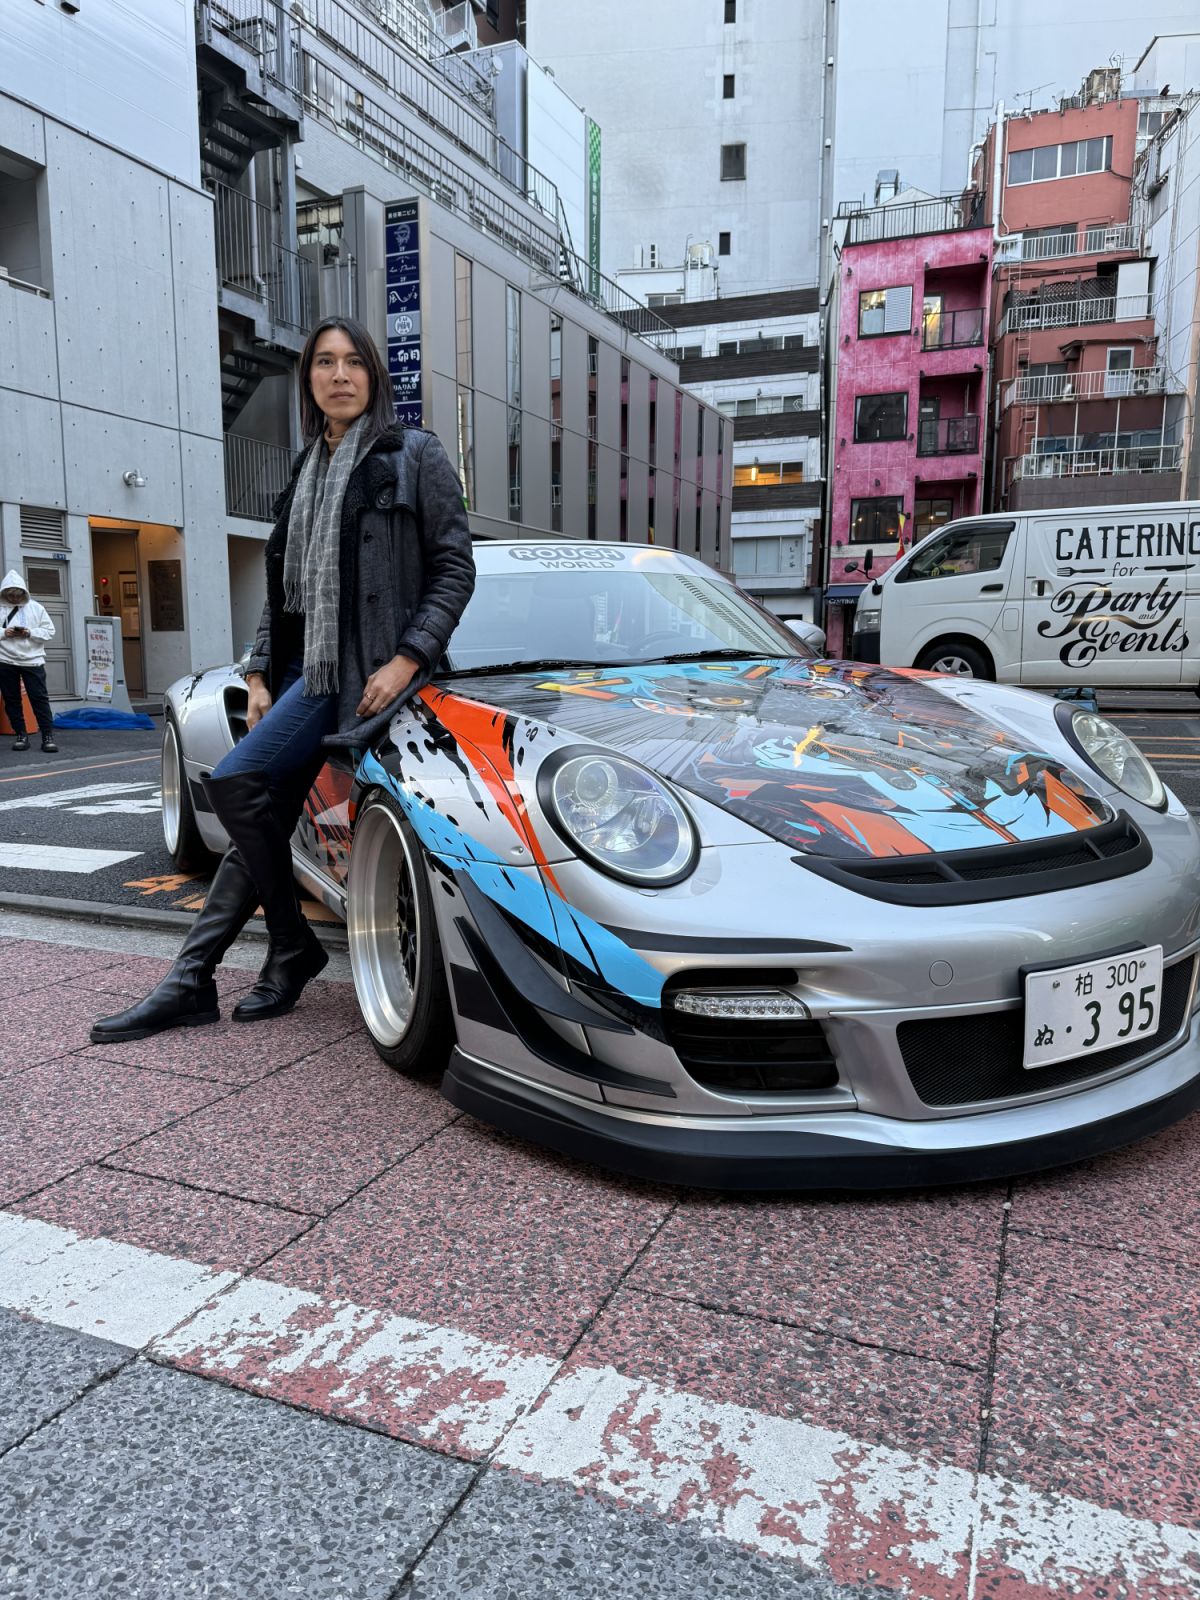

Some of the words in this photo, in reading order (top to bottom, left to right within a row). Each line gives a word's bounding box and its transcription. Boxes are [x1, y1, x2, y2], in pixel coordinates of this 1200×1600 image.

[511, 548, 622, 560] ROUGH
[540, 561, 616, 569] WORLD
[1112, 561, 1139, 577] for
[1037, 577, 1183, 638] Party
[1138, 610, 1159, 620] and
[1059, 617, 1190, 669] Events
[1075, 971, 1093, 997] 柏
[1105, 960, 1138, 989] 300
[1034, 1023, 1054, 1047] ぬ
